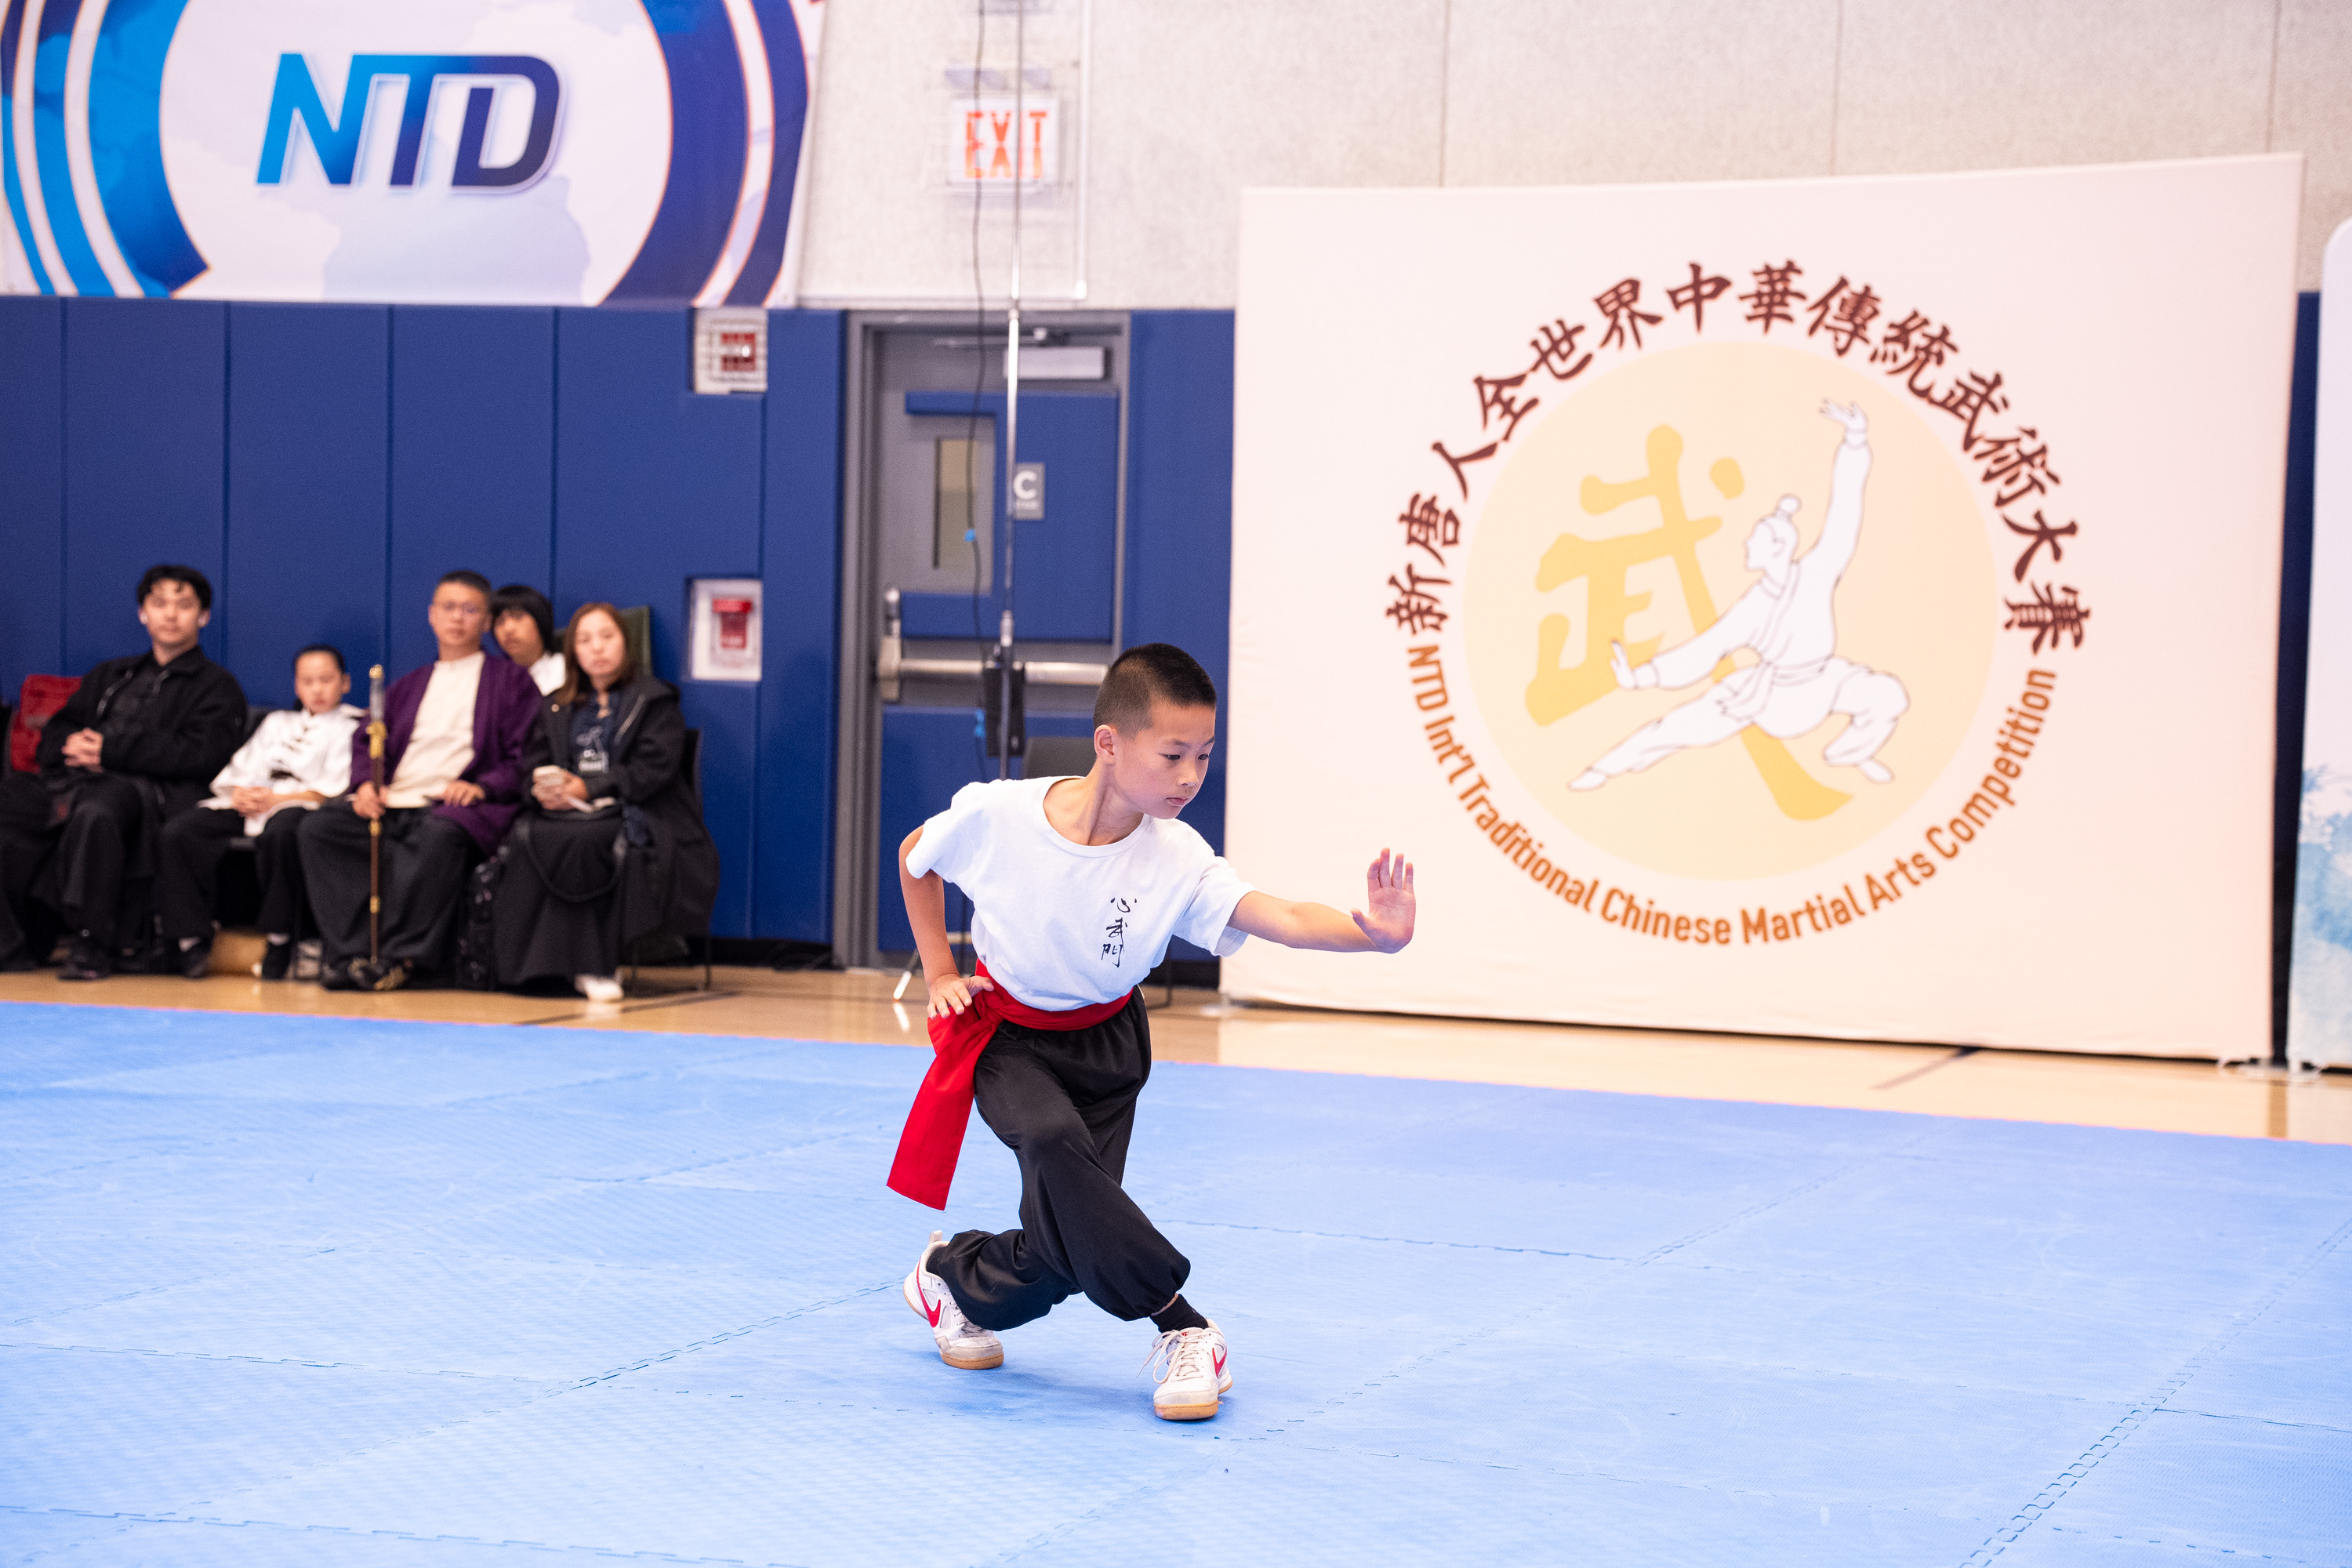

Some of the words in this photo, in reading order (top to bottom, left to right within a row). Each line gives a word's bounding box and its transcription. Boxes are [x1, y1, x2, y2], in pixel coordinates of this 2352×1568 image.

[257, 53, 561, 188] NTD
[1014, 470, 1037, 499] C
[1385, 260, 2092, 656] 新唐人全世界中華傳統武術大賽
[1407, 644, 1449, 712] NTD
[1458, 773, 1599, 913] Traditional
[1601, 887, 1731, 946] Chinese
[1740, 884, 1866, 944] Martial
[1865, 850, 1937, 911] Arts
[1926, 669, 2057, 859] Competition
